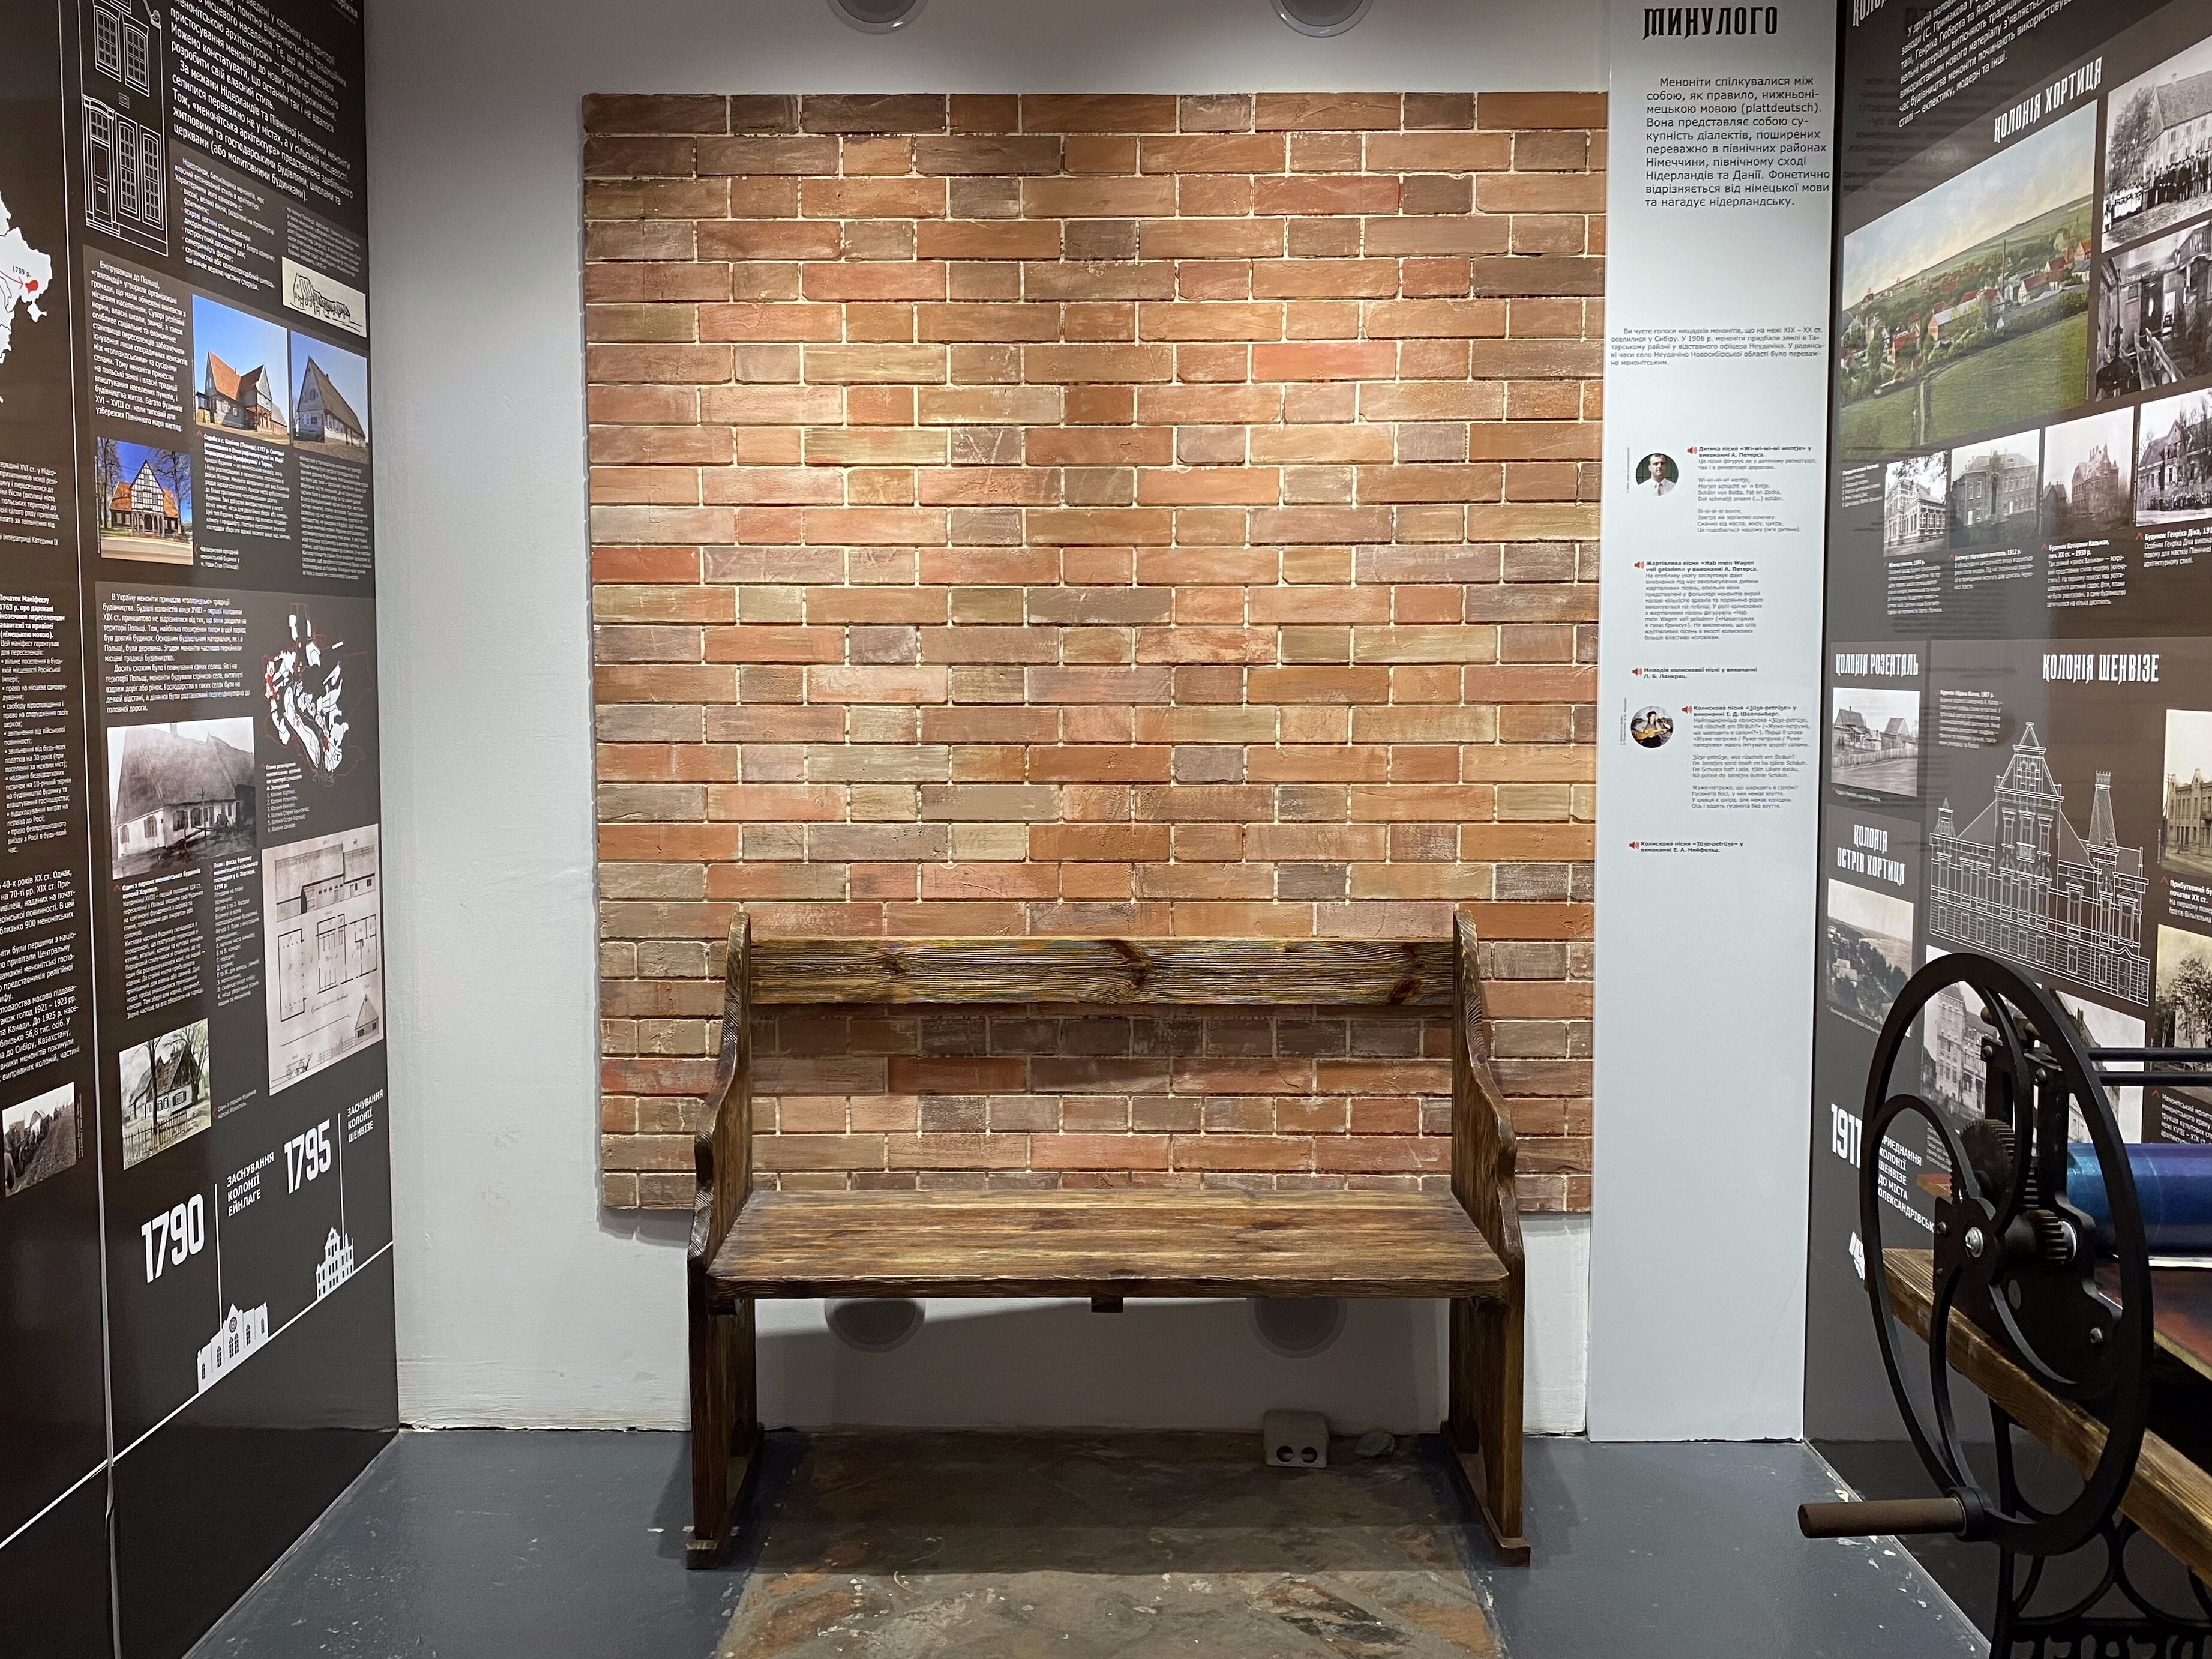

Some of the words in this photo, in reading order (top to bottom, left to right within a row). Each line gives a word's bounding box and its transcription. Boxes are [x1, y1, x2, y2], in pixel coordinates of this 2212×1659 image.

[1642, 6, 1777, 40] МИНУЛОГО
[1659, 77, 1710, 86] Меноніти
[1715, 77, 1790, 87] спілкувалися
[1794, 76, 1814, 85] між
[1647, 91, 1685, 101] собою,
[1707, 92, 1757, 101] правило,
[1762, 89, 1819, 99] нижньоні-
[1994, 92, 2040, 143] КОЛОНІЯ
[2045, 56, 2102, 114] ХОРТИЦЯ
[1647, 106, 1696, 115] мецькою
[1741, 102, 1821, 115] (plattdeutsch).
[1647, 118, 1674, 127] Вона
[1678, 118, 1749, 128] представляє
[1752, 116, 1787, 125] собою
[1791, 118, 1808, 127] су-
[1646, 131, 1694, 142] купність
[1697, 130, 1752, 141] діалектів,
[1757, 131, 1820, 141] поширених
[1646, 146, 1708, 155] переважно
[1722, 143, 1775, 152] північних
[1779, 142, 1826, 154] районах
[1646, 157, 1709, 168] Німеччини,
[1713, 157, 1773, 168] північному
[1777, 156, 1806, 166] сході
[1645, 170, 1713, 182] Нідерландів
[1732, 170, 1764, 181] Данії.
[1768, 170, 1830, 179] Фонетично
[1645, 184, 1720, 195] відрізняється
[1724, 184, 1740, 194] від
[1745, 182, 1798, 193] німецької
[1661, 199, 1706, 208] нагадує
[1709, 197, 1794, 208] нідерландську.
[12, 265, 25, 275] 1789
[1835, 653, 1868, 676] КОЛОНІЯ
[1870, 653, 1918, 677] РОЗЕНТАЛЬ
[2042, 654, 2094, 684] КОЛОНІЯ
[2098, 653, 2159, 685] ШЕНВІЗЕ
[1853, 824, 1887, 854] КОЛОНІЯ
[1837, 846, 1864, 873] ОСТРІВ
[1866, 854, 1905, 886] ХОРТИЦЯ
[25, 1027, 38, 1039] 56,8
[347, 1089, 383, 1117] ЗАСНУВАННЯ
[347, 1106, 372, 1130] КОЛОНІЇ
[348, 1120, 373, 1143] ШЕНВІЗЕ
[284, 1119, 331, 1194] 1795
[1879, 1146, 1906, 1171] КОЛОНІЇ
[1881, 1135, 1921, 1166] РИЄДНАННЯ
[226, 1151, 274, 1187] ЗАСНУВАННЯ
[1878, 1159, 1907, 1185] ШЕНВІЗЕ
[227, 1174, 260, 1202] КОЛОНІЇ
[1878, 1173, 1887, 1186] ДО
[1888, 1179, 1908, 1200] МІСТА
[228, 1188, 260, 1217] ЕЙНЛАГЕ
[142, 1194, 205, 1284] 1790
